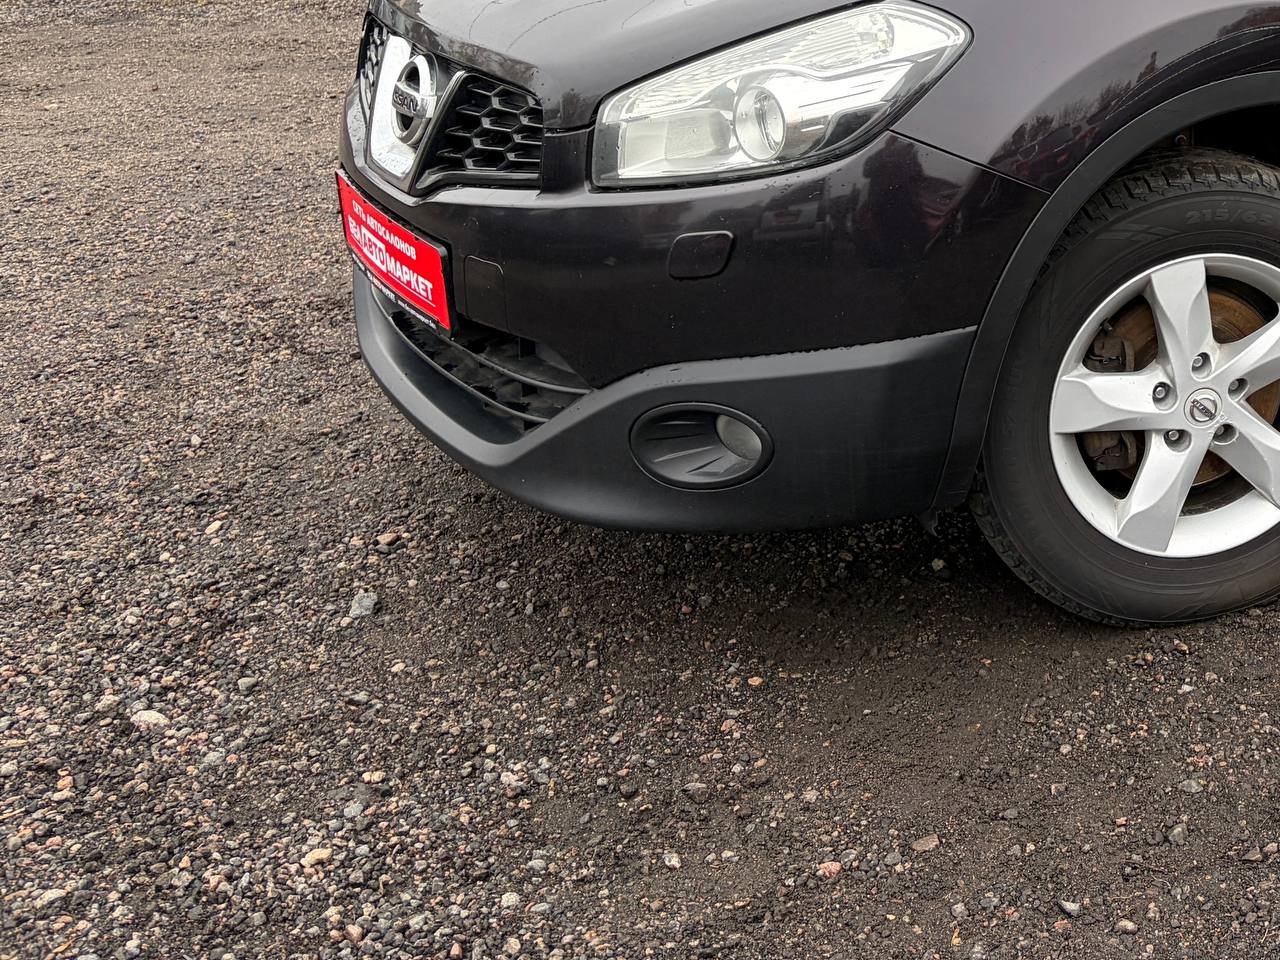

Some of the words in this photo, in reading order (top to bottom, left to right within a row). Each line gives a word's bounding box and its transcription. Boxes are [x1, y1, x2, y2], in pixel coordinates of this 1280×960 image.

[348, 214, 361, 241] БЕЛ
[362, 228, 386, 270] АВТО
[385, 252, 433, 301] МАРКЕТ
[352, 199, 366, 222] СЕТЬ
[366, 213, 417, 261] АВТОСАЛОНОВ
